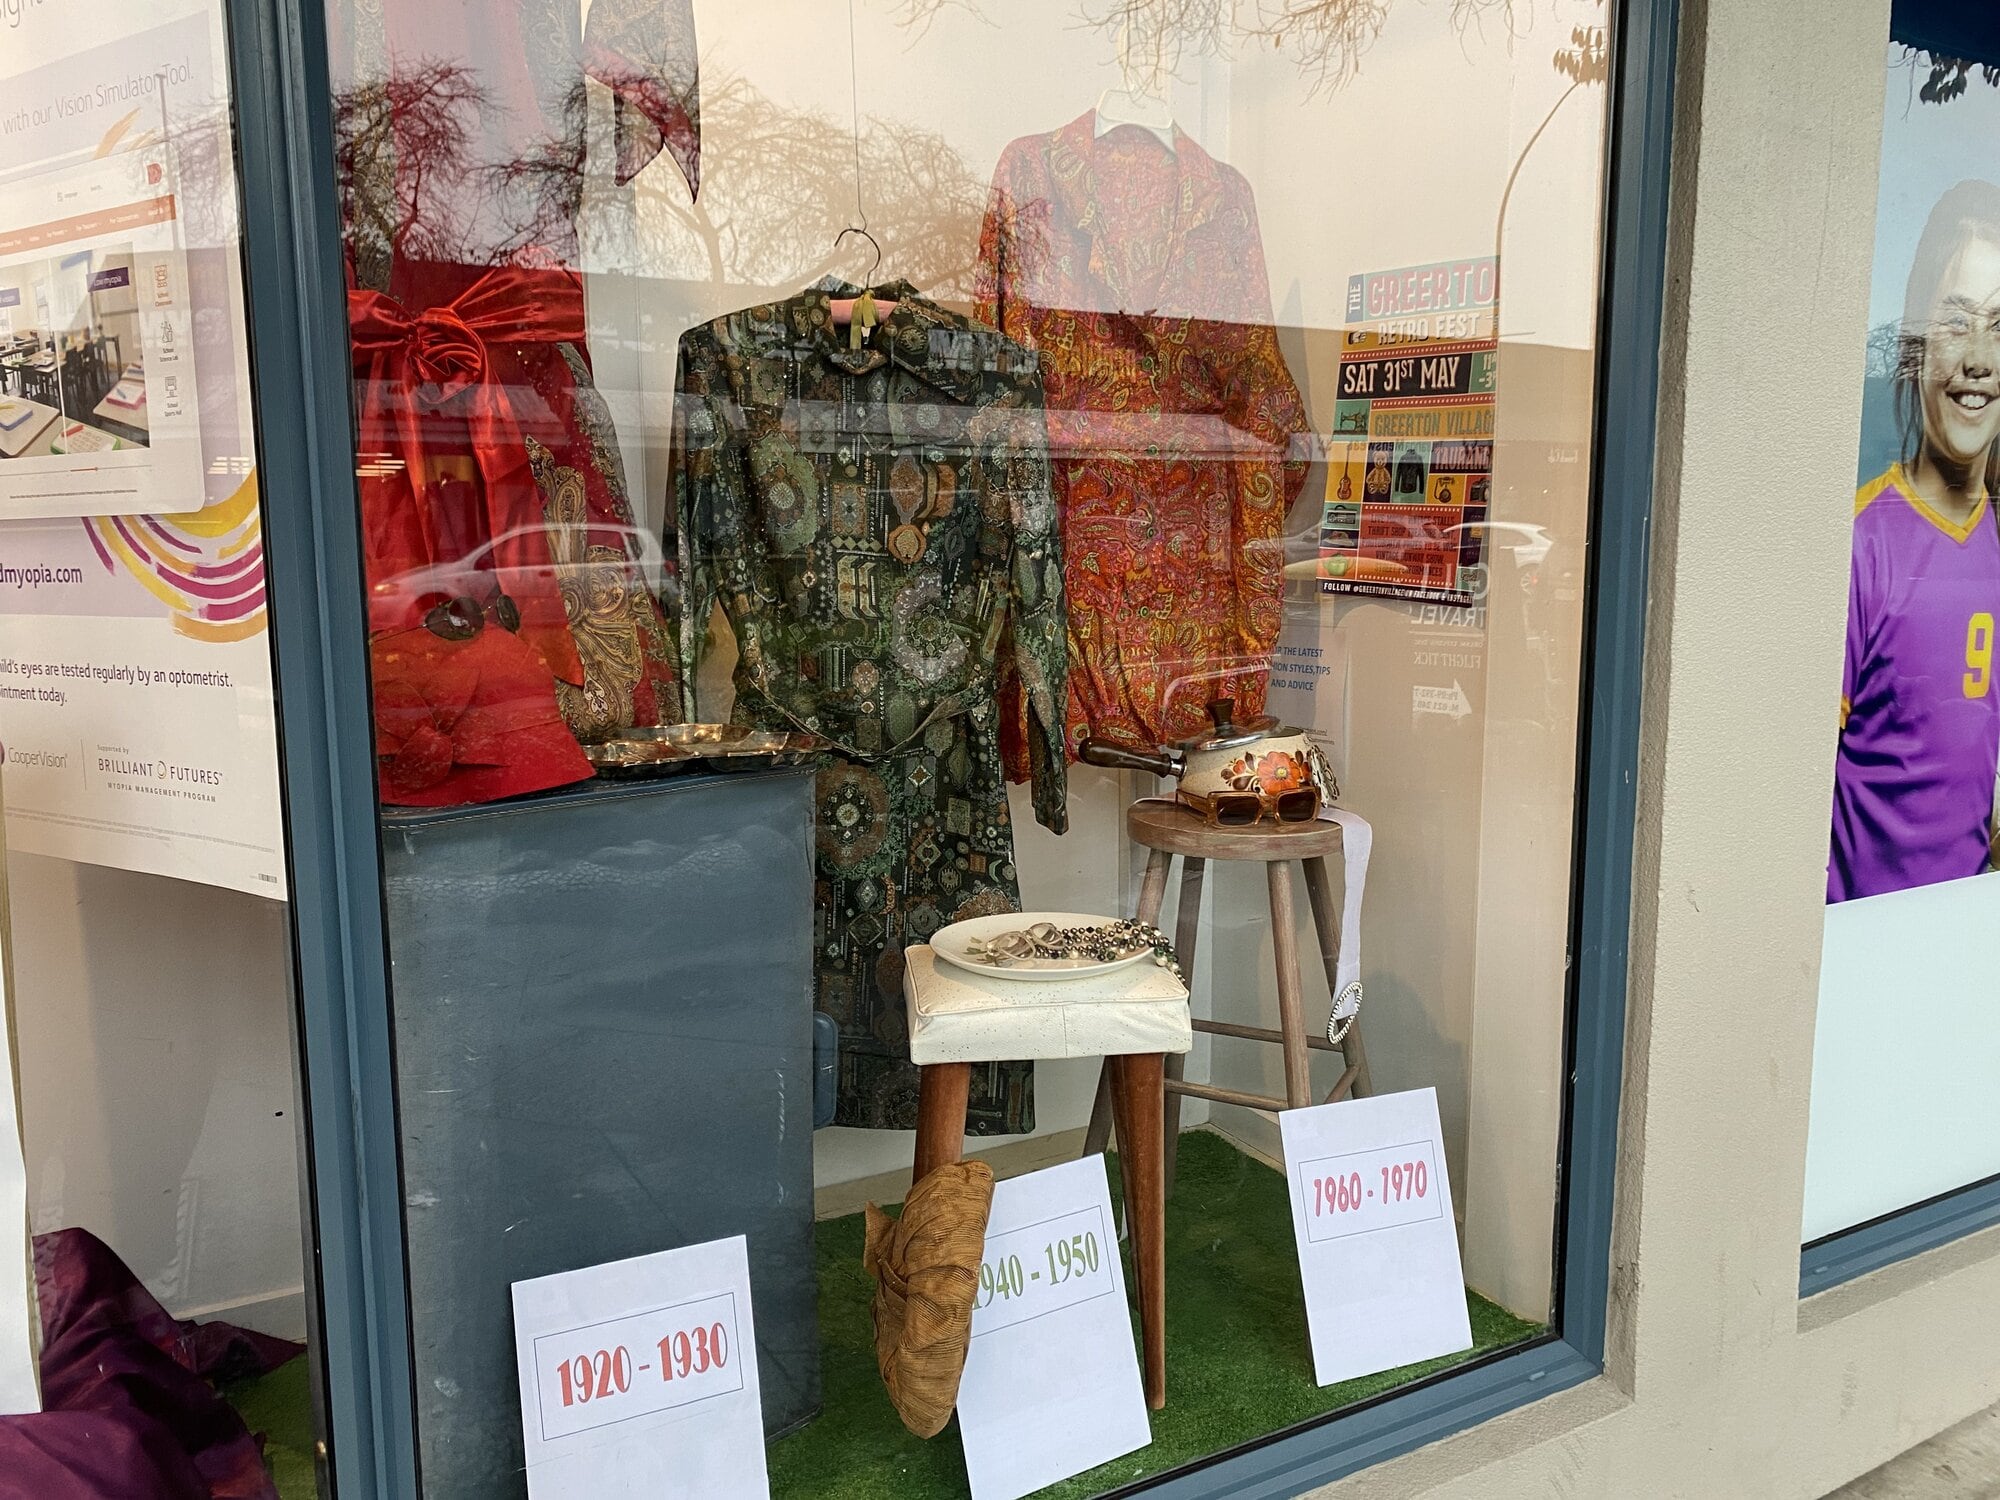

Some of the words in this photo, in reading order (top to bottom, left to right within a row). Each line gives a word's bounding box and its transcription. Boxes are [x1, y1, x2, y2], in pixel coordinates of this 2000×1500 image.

[3, 110, 30, 134] with
[33, 106, 52, 126] our
[55, 94, 93, 118] Vision
[95, 75, 161, 107] Simulator
[161, 56, 194, 87] Tool.
[1349, 283, 1361, 314] THE
[1377, 318, 1429, 346] RETRO
[1435, 312, 1481, 341] FEST
[1343, 363, 1378, 394] SAT
[1384, 359, 1415, 392] 31ST
[1420, 356, 1461, 390] MAY
[1374, 412, 1441, 437] GREERTON
[1323, 582, 1351, 592] FOLLOW
[1284, 646, 1297, 657] THE
[1298, 647, 1324, 658] LATEST
[1963, 611, 1994, 699] 9
[21, 663, 43, 679] eyes
[45, 664, 59, 676] are
[61, 663, 91, 678] tested
[93, 664, 134, 685] regularly
[137, 665, 151, 686] by
[154, 670, 166, 683] an
[168, 669, 233, 688] optometrist.
[1271, 678, 1286, 688] AND
[1287, 679, 1314, 691] ADVICE
[0, 684, 37, 701] intment
[38, 686, 67, 707] today.
[97, 743, 121, 753] Supported
[98, 758, 153, 777] BRILLIANT
[107, 782, 132, 791] MYOPIA
[135, 785, 180, 798] MANAGEMENT
[183, 791, 216, 803] PROGRAM
[1313, 1171, 1362, 1218] 1960
[1381, 1160, 1428, 1205] 1970
[972, 1254, 1024, 1311] 940
[1044, 1231, 1099, 1286] 1950
[557, 1345, 632, 1408] 1920
[656, 1322, 728, 1382] 1930
